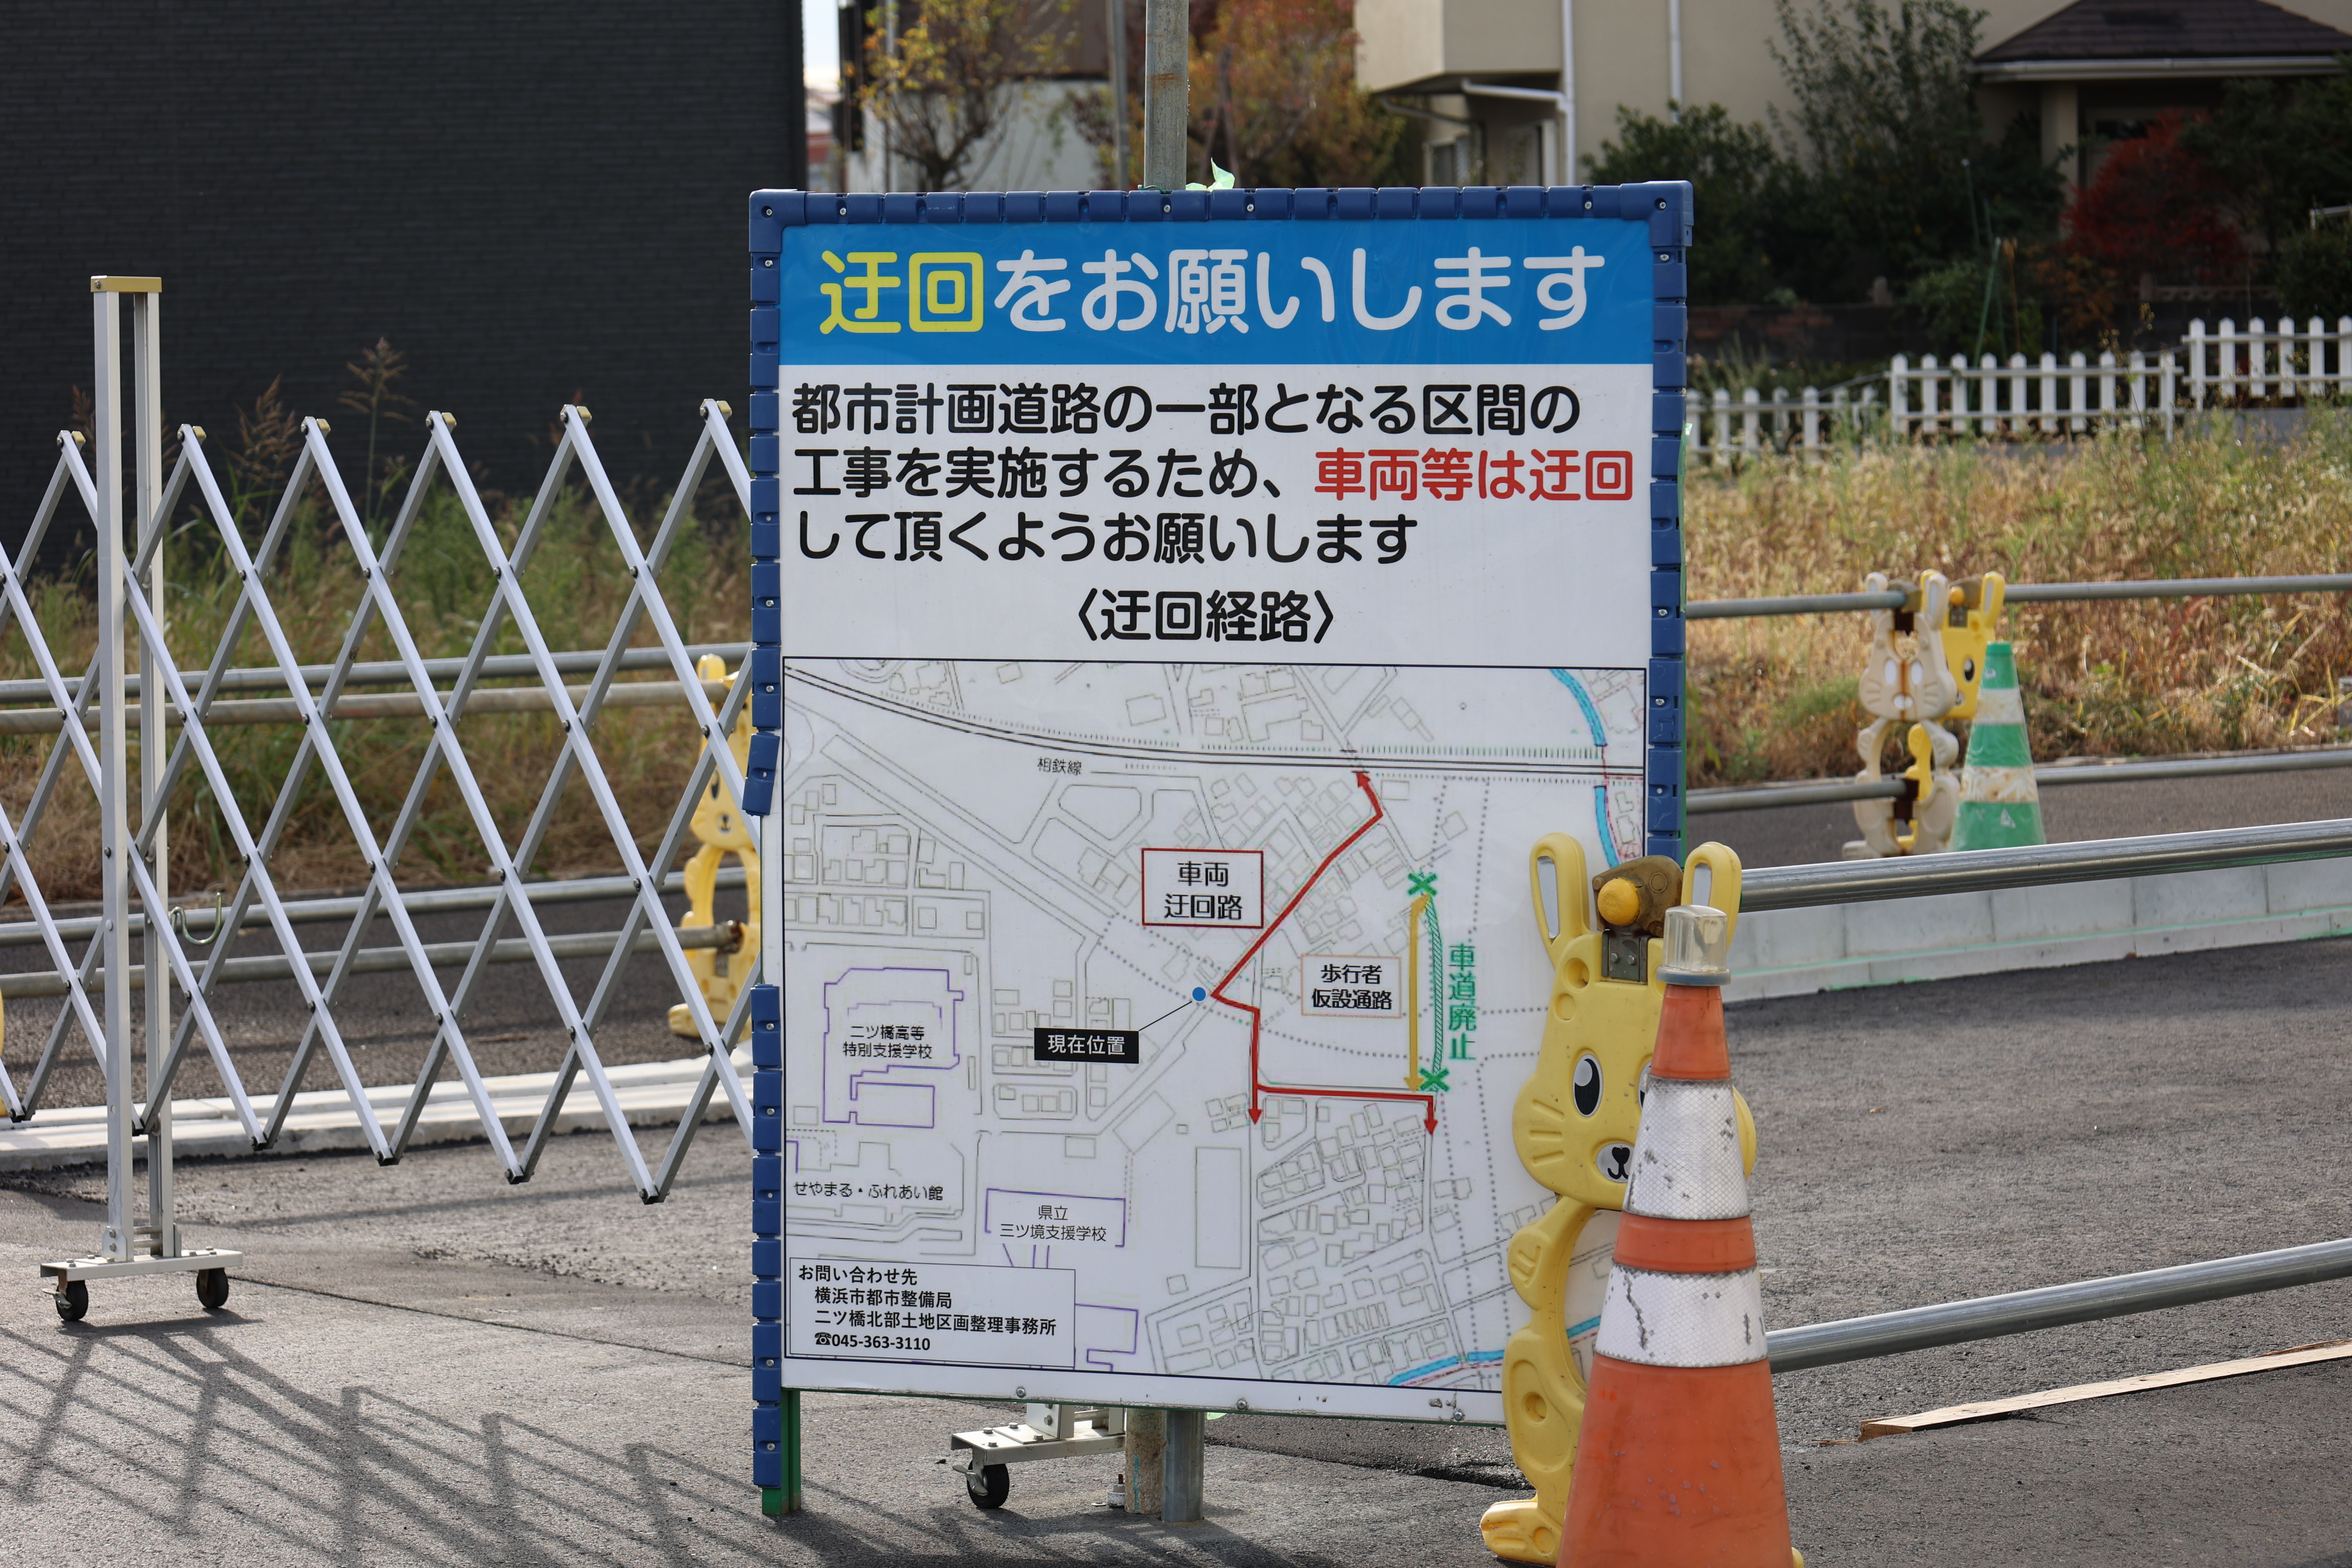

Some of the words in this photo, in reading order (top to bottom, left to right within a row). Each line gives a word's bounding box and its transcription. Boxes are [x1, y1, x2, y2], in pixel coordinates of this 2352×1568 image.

[820, 246, 1605, 334] 迂回をお願いします
[792, 382, 1580, 436] 都市計画道路の一部となる区間の
[799, 510, 1418, 564] して頂くようお願いします
[1078, 588, 1334, 644] 〈迂回経路〉
[1037, 756, 1082, 775] 相鉄線
[1177, 861, 1229, 887] 車両
[1164, 893, 1243, 921] 迂回路
[1320, 963, 1383, 984] 歩行者
[1311, 988, 1393, 1010] 仮設通路
[1447, 942, 1476, 1061] 車道廃止
[850, 1024, 925, 1041] 二ツ橋高等
[842, 1041, 932, 1059] 特別支援学校
[1048, 1035, 1125, 1055] 現在位置
[794, 1181, 943, 1201] せやまる・ふれあい館
[1038, 1205, 1068, 1220] 県立
[1000, 1224, 1106, 1242] 三ツ境支援学校
[798, 1265, 918, 1285] お問い合わせ先
[815, 1286, 952, 1309] 横浜市都市整備局
[814, 1309, 1057, 1336] 二ツ橋北部土地区画整理事務所
[832, 1334, 931, 1351] 045-363-3110
